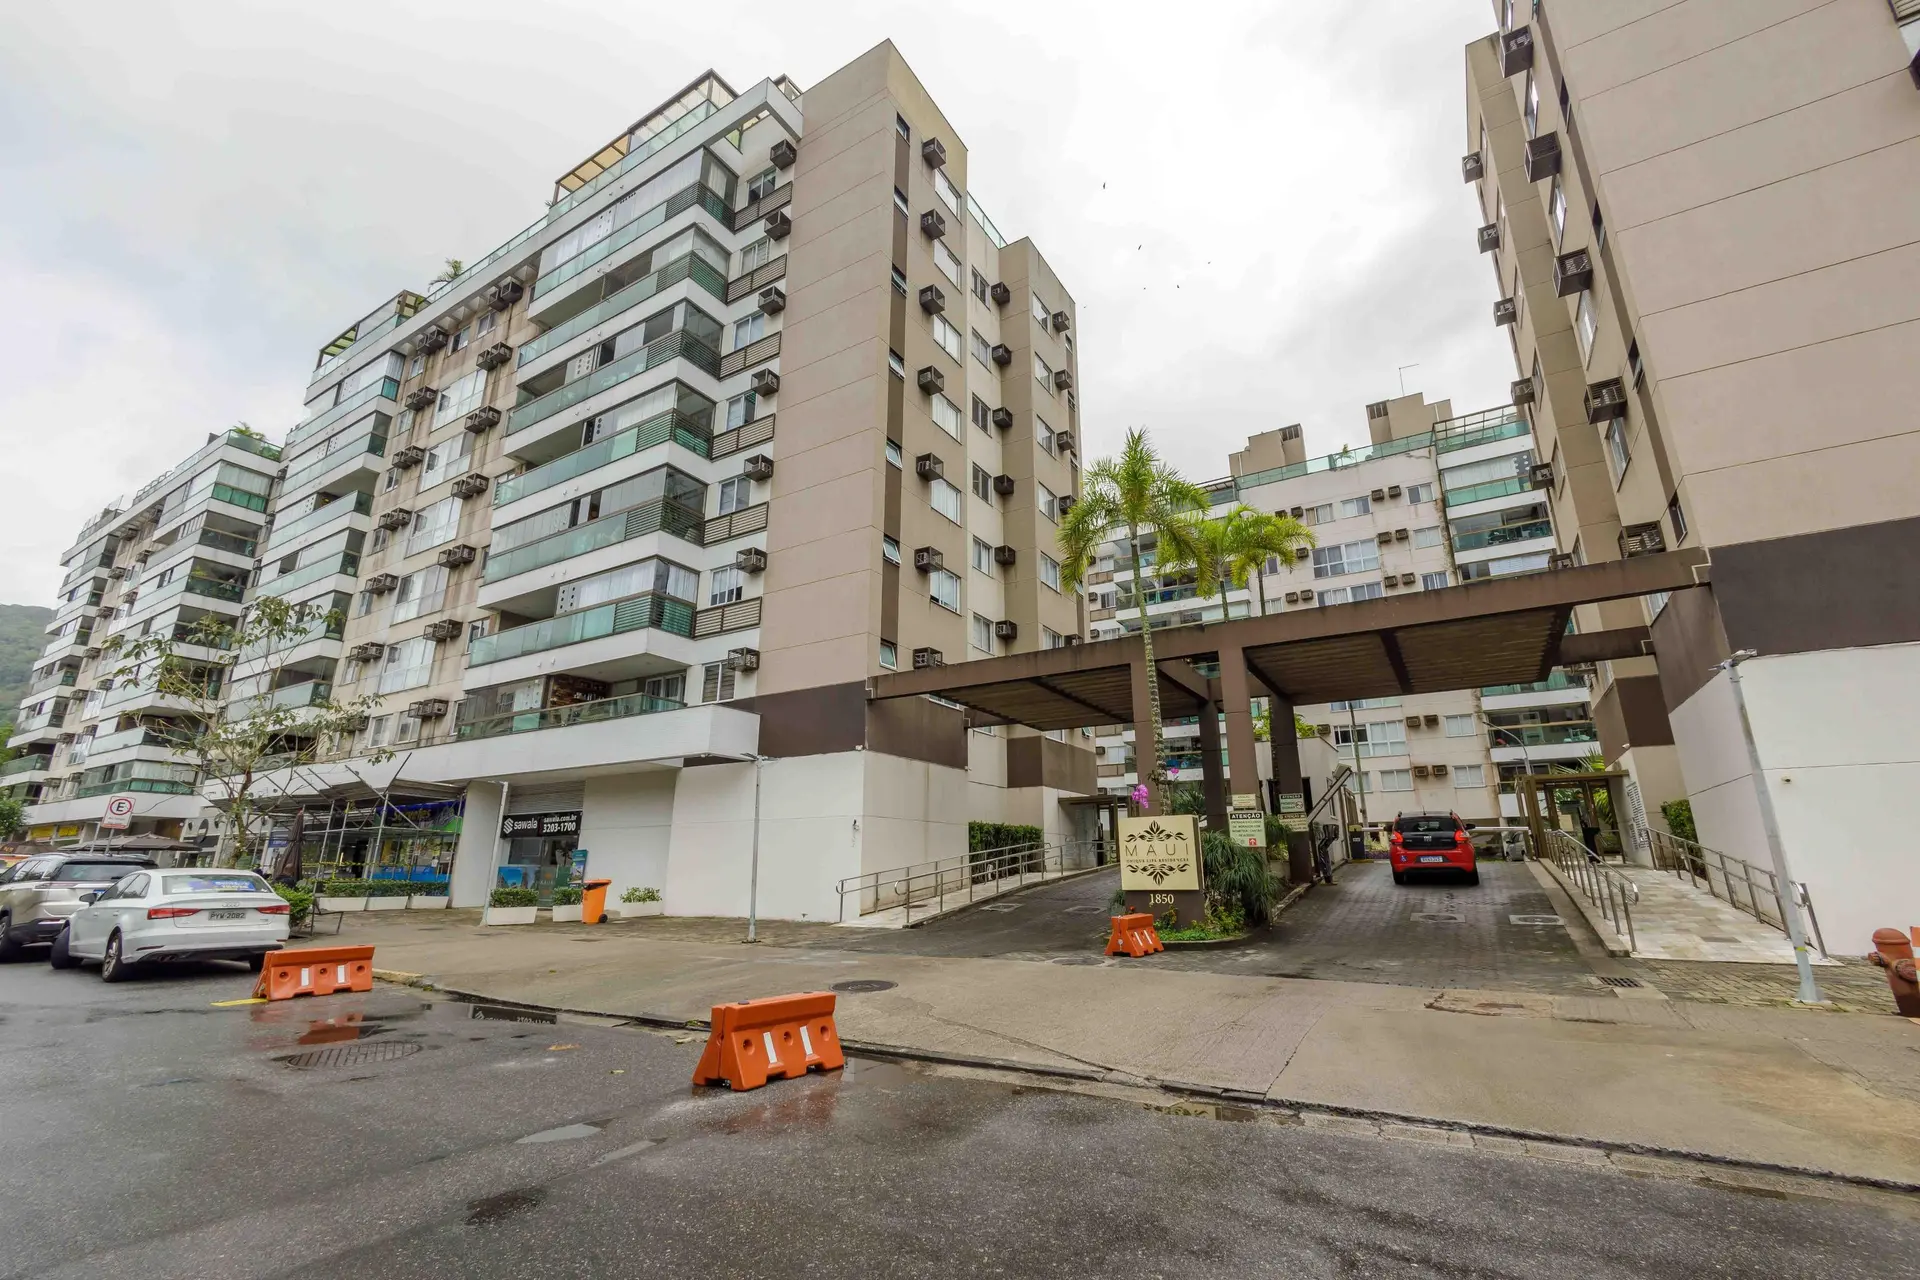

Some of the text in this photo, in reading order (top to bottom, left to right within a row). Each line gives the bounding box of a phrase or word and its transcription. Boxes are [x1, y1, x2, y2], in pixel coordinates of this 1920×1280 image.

[116, 802, 126, 812] E
[514, 818, 538, 830] sawala
[543, 822, 576, 833] 3203-1700
[1125, 843, 1189, 857] MAUI
[1149, 893, 1174, 904] 1850
